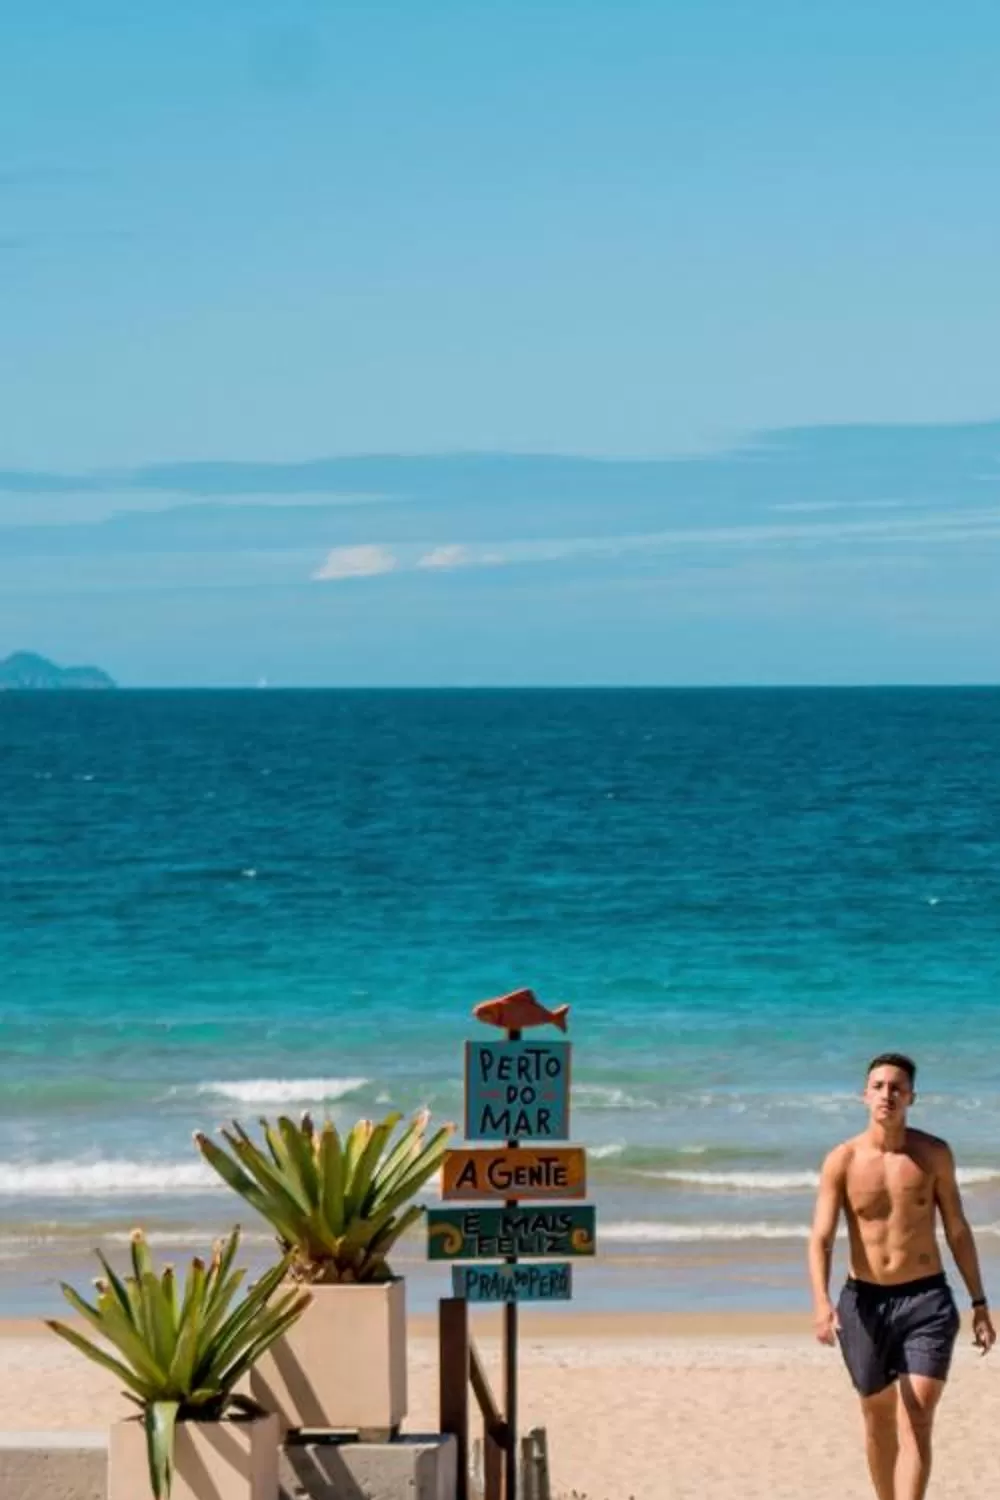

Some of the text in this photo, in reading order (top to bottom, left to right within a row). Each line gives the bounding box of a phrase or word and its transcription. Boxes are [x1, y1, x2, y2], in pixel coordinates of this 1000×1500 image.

[479, 1048, 561, 1083] PERTO
[506, 1085, 536, 1104] DO
[479, 1104, 551, 1136] MAR
[455, 1157, 568, 1190] A GENTE
[500, 1213, 572, 1238] MAIS
[476, 1236, 564, 1255] FELIZ
[465, 1269, 516, 1299] PRAIA
